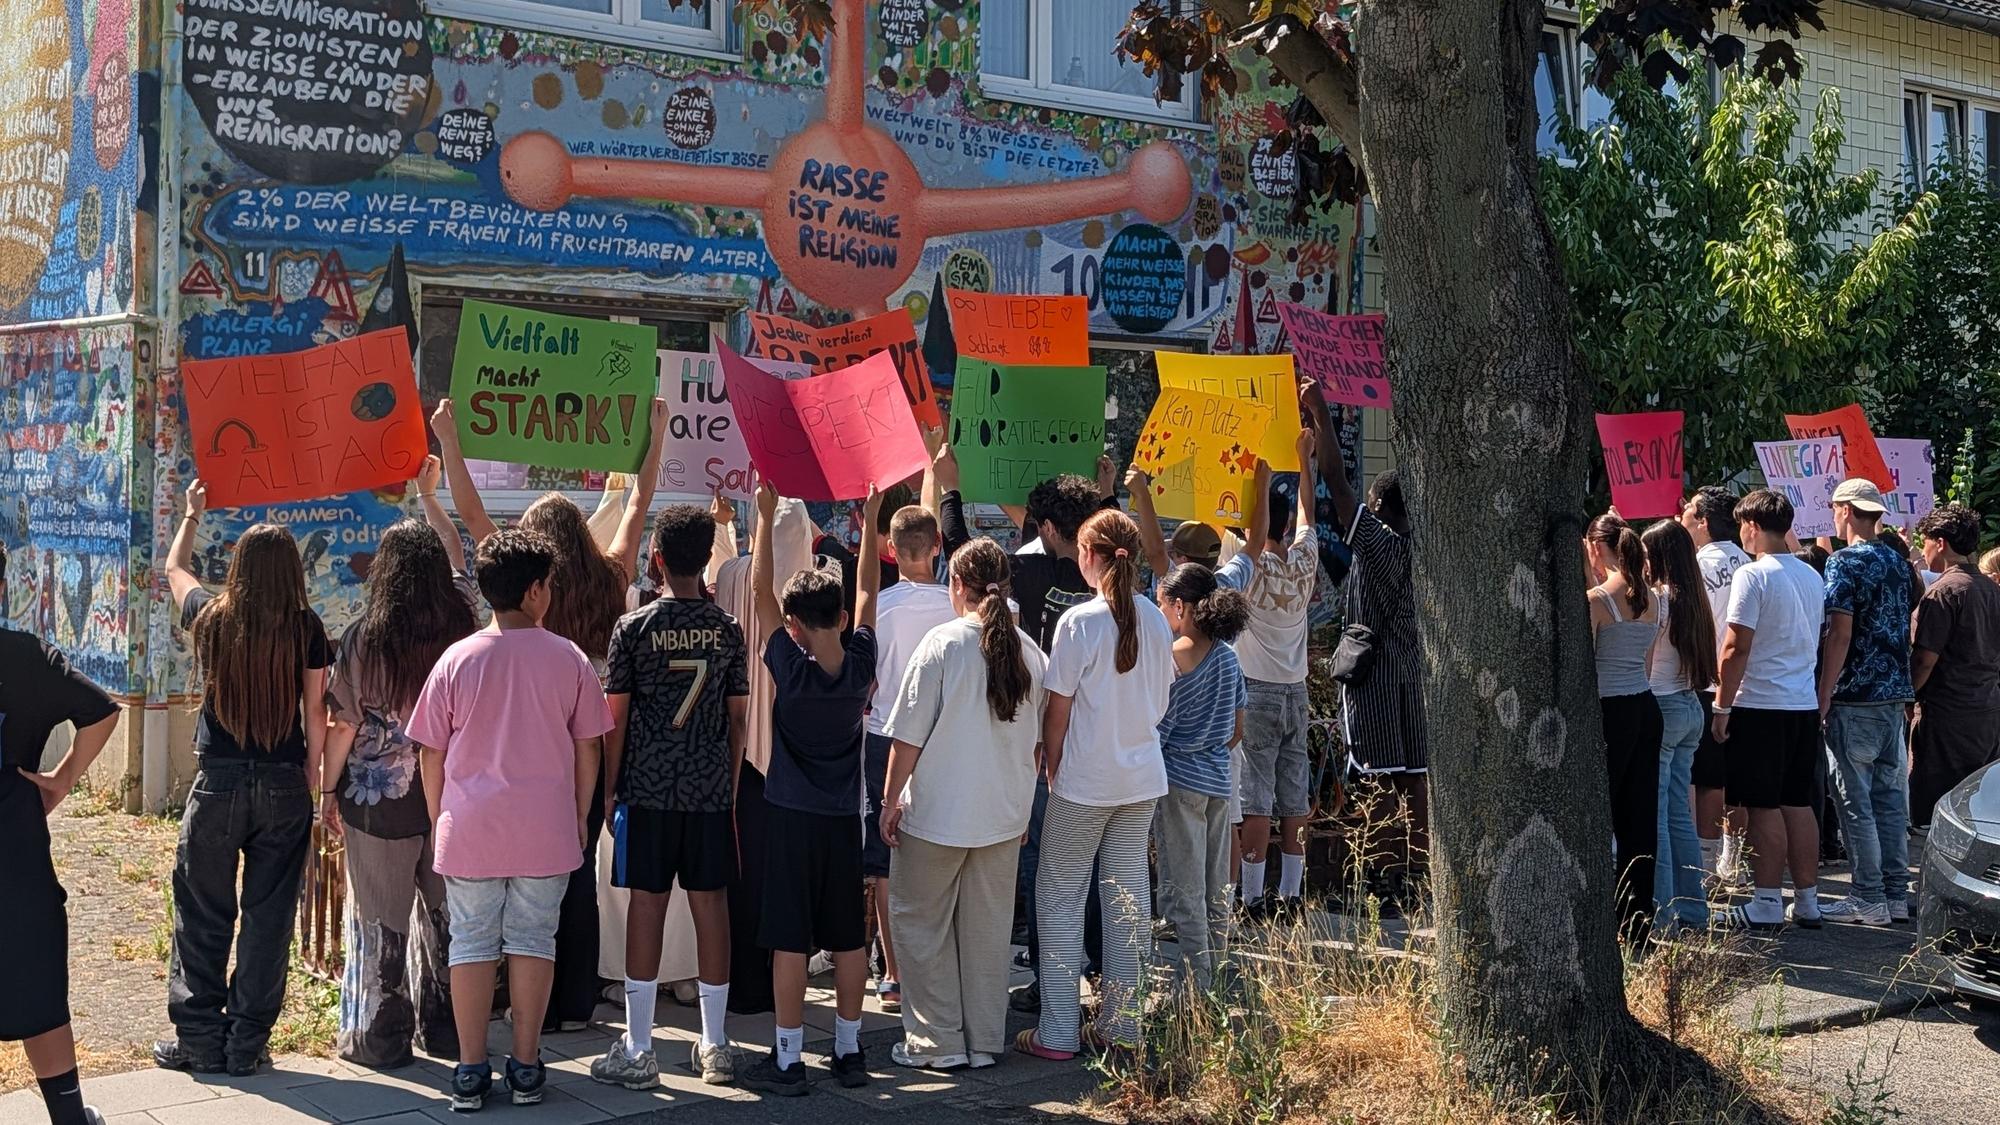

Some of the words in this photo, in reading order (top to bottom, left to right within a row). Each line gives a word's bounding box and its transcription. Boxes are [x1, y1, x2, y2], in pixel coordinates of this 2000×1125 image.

[185, 15, 238, 42] DER
[885, 31, 921, 46] WEM?
[324, 61, 427, 99] LÄNDER
[216, 96, 276, 120] UNS
[666, 108, 708, 124] ENKEL
[438, 126, 494, 149] RENTE?
[568, 140, 596, 155] WER
[958, 123, 983, 143] 8%
[441, 144, 483, 162] WEG?
[894, 127, 929, 146] UND
[935, 136, 956, 152] DU
[1037, 155, 1100, 175] LETZTE?
[800, 158, 889, 202] RASSE
[237, 189, 284, 209] 2%
[295, 190, 351, 213] DER
[366, 192, 628, 233] WELTBEVÖLKERUNG
[550, 231, 694, 262] FRUCHTBAREN
[701, 246, 767, 273] ALTER!
[1114, 234, 1172, 254] MACHT
[1104, 256, 1140, 269] MEHR
[950, 270, 983, 287] GRA
[1164, 276, 1185, 291] DAS
[1105, 288, 1156, 302] HASSEN
[1107, 304, 1126, 316] AM
[983, 298, 1060, 330] LIEBE
[479, 312, 580, 356] Vielfalt
[755, 314, 813, 345] Jeder
[816, 326, 874, 349] verdient
[188, 332, 406, 401] VIELFALT
[476, 364, 541, 387] Macht
[957, 361, 1001, 416] FÜR
[282, 392, 339, 440] IST
[469, 390, 637, 447] STARK!
[669, 413, 731, 443] are
[735, 379, 898, 459] RESPEKT
[1161, 393, 1194, 429] Kein
[1199, 398, 1242, 438] Platz
[1047, 420, 1103, 445] GEGEN
[1182, 435, 1203, 457] für
[236, 420, 411, 496] ALLTAG
[988, 455, 1049, 491] HETZE
[1603, 429, 1682, 487] TOLERANZ
[1171, 463, 1215, 496] HASS
[650, 625, 723, 652] MBAPPÉ
[668, 658, 709, 729] 7
